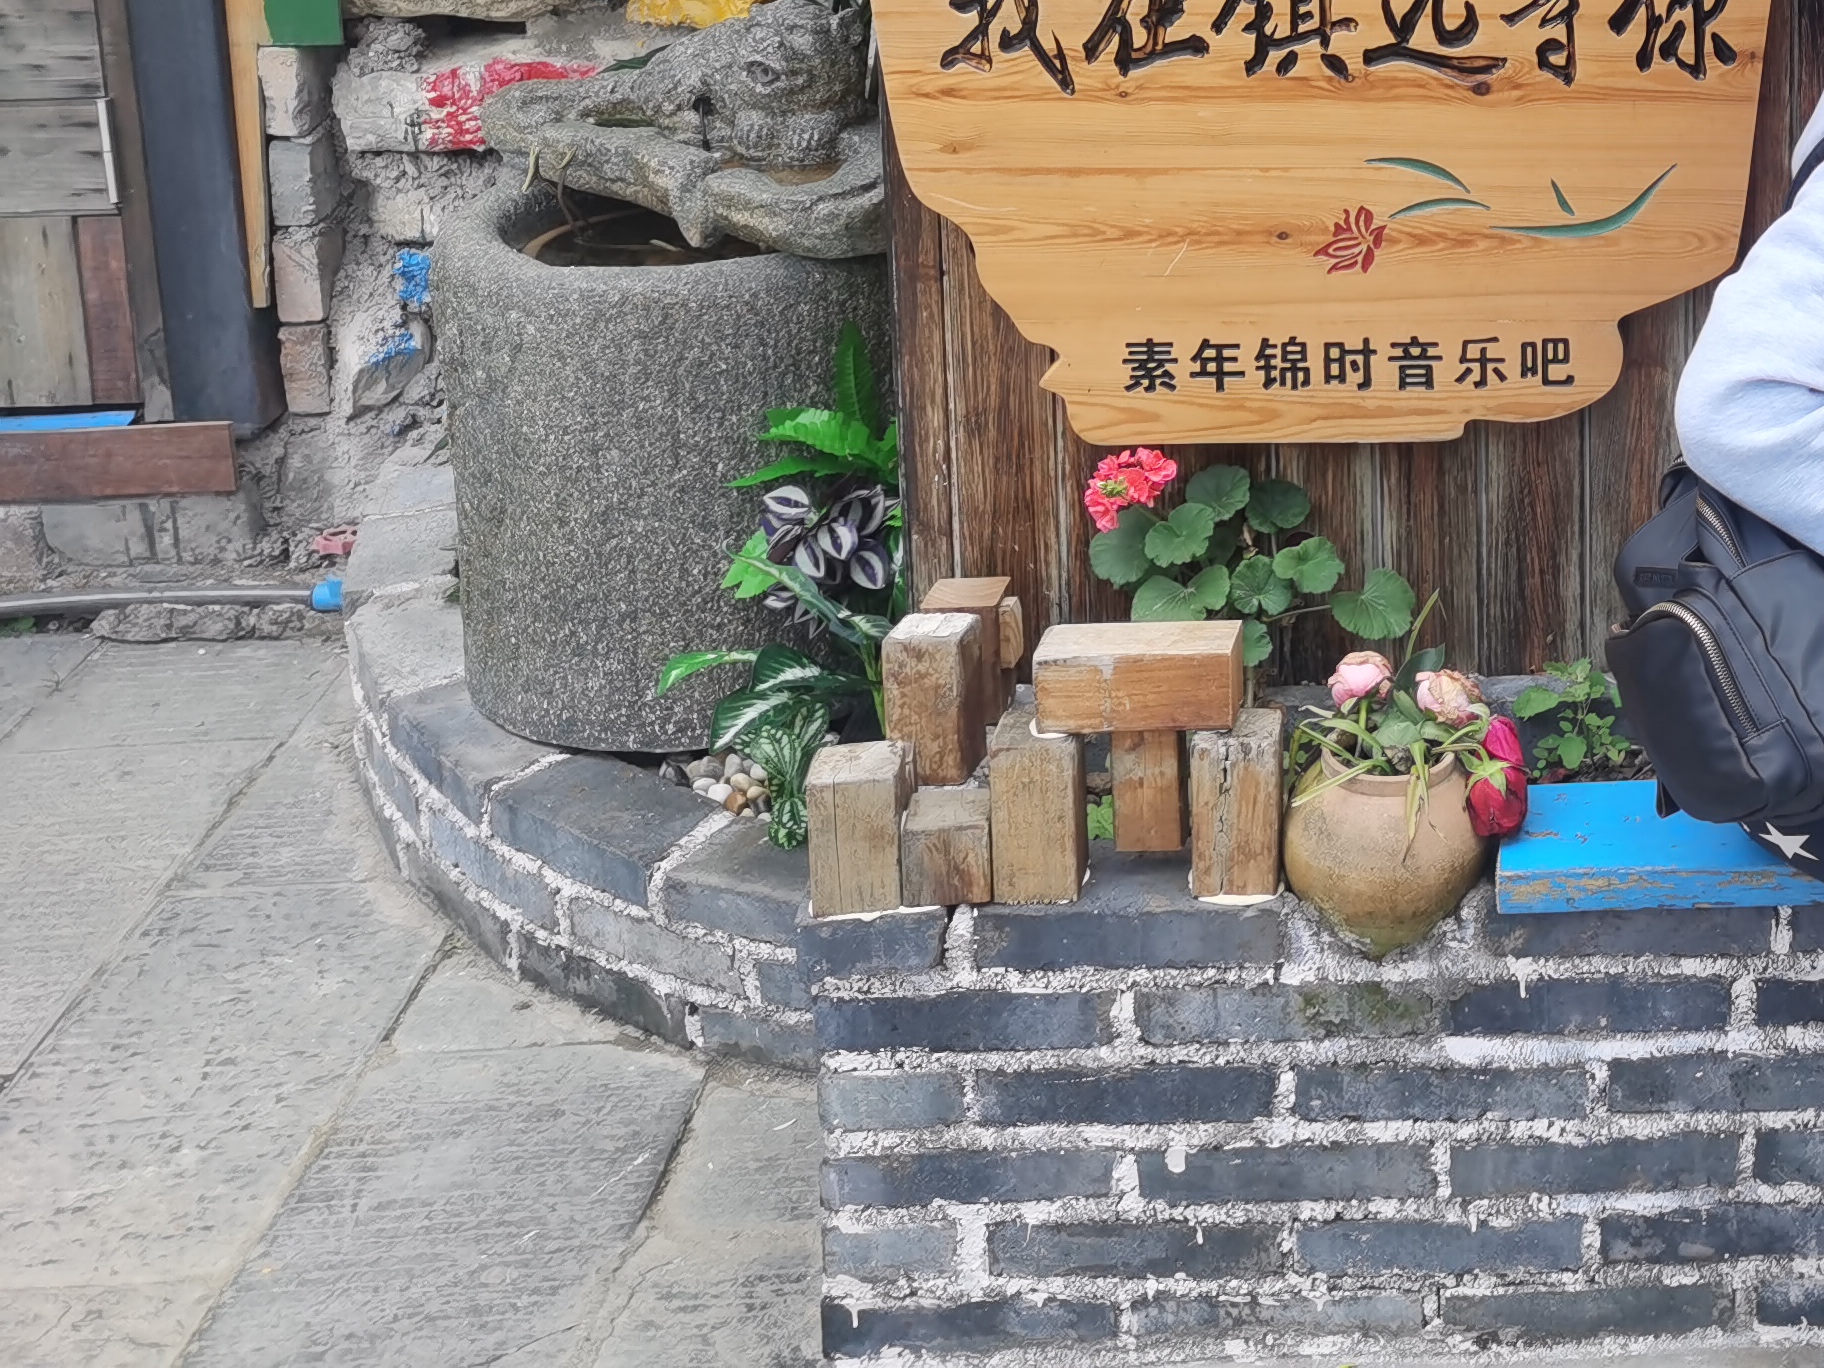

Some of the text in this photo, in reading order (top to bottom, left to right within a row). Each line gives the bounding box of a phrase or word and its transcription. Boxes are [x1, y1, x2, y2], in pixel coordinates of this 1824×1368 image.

[1122, 335, 1576, 395] 素年锦时音乐吧
